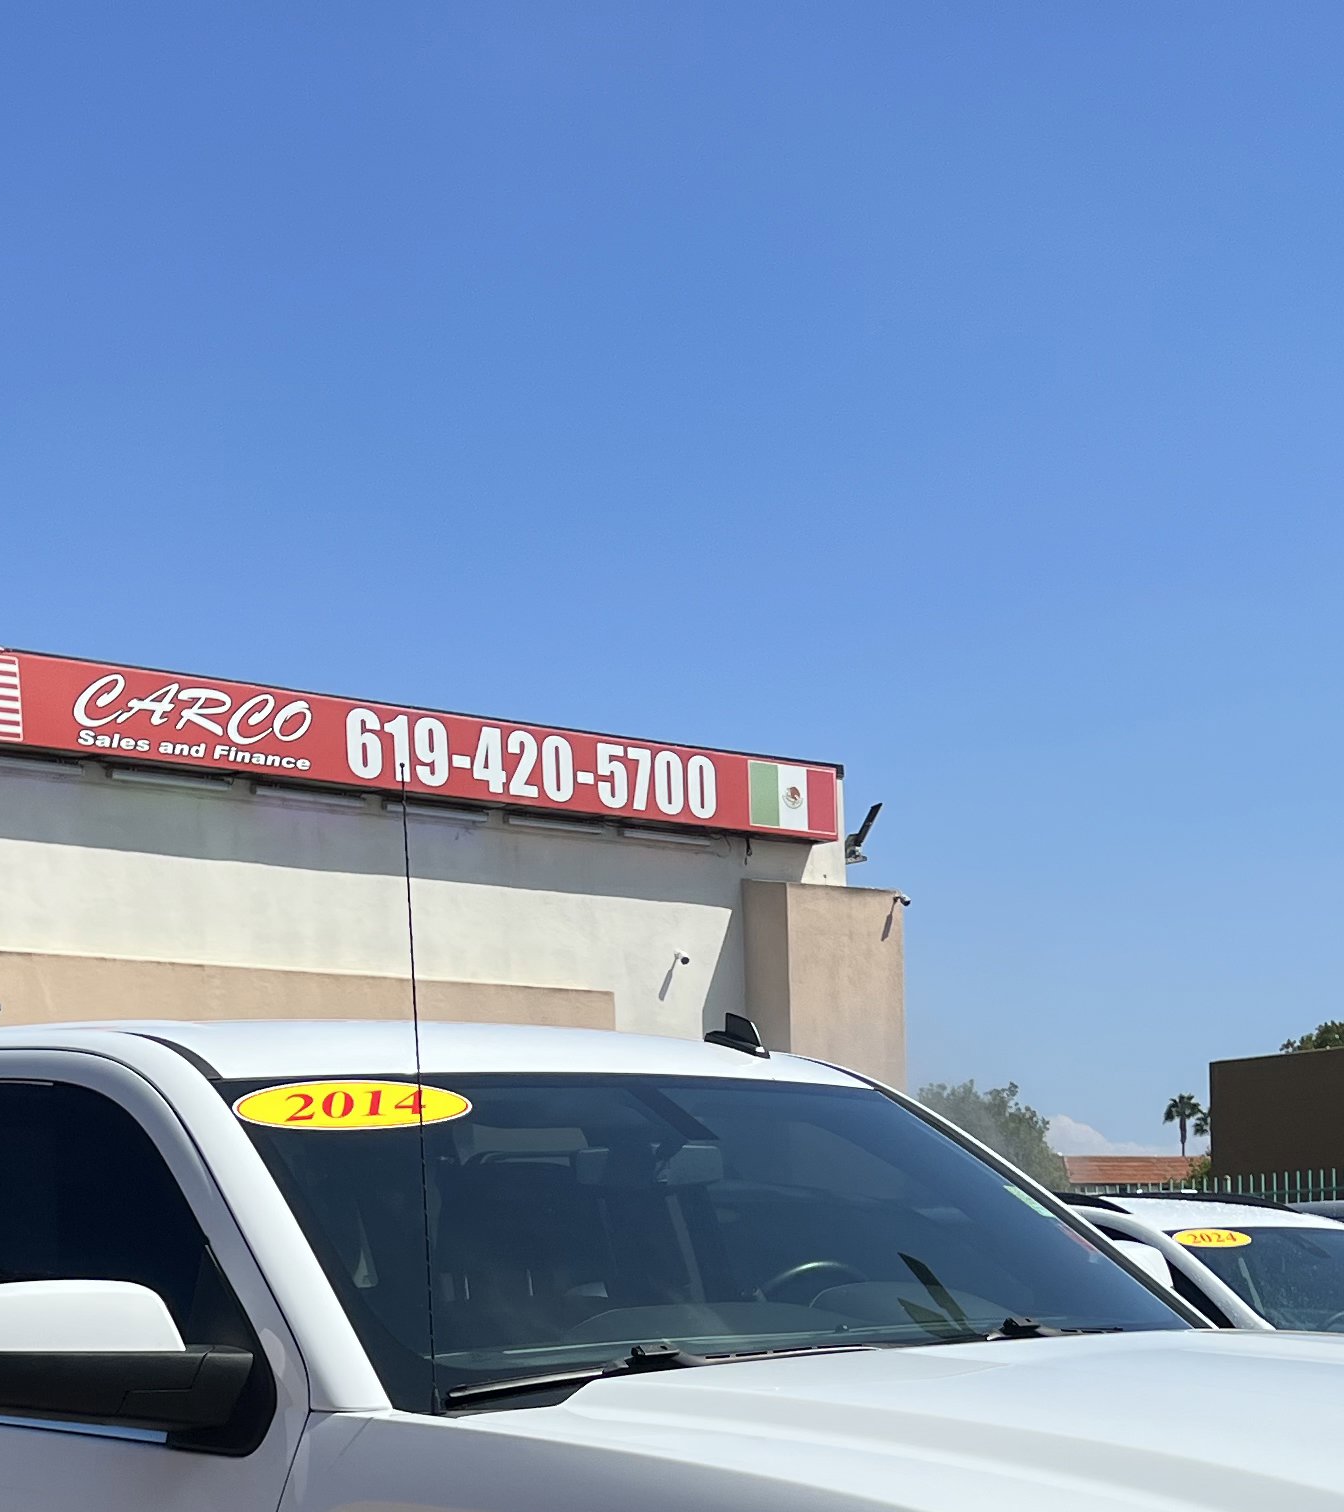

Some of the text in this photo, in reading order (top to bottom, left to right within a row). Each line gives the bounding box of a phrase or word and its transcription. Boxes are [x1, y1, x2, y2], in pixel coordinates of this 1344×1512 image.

[73, 673, 313, 745] CARCO
[77, 728, 312, 771] Sales and Finance
[345, 707, 718, 820] 619-420-5700
[285, 1089, 426, 1122] 2014
[1187, 1231, 1237, 1244] 2024
